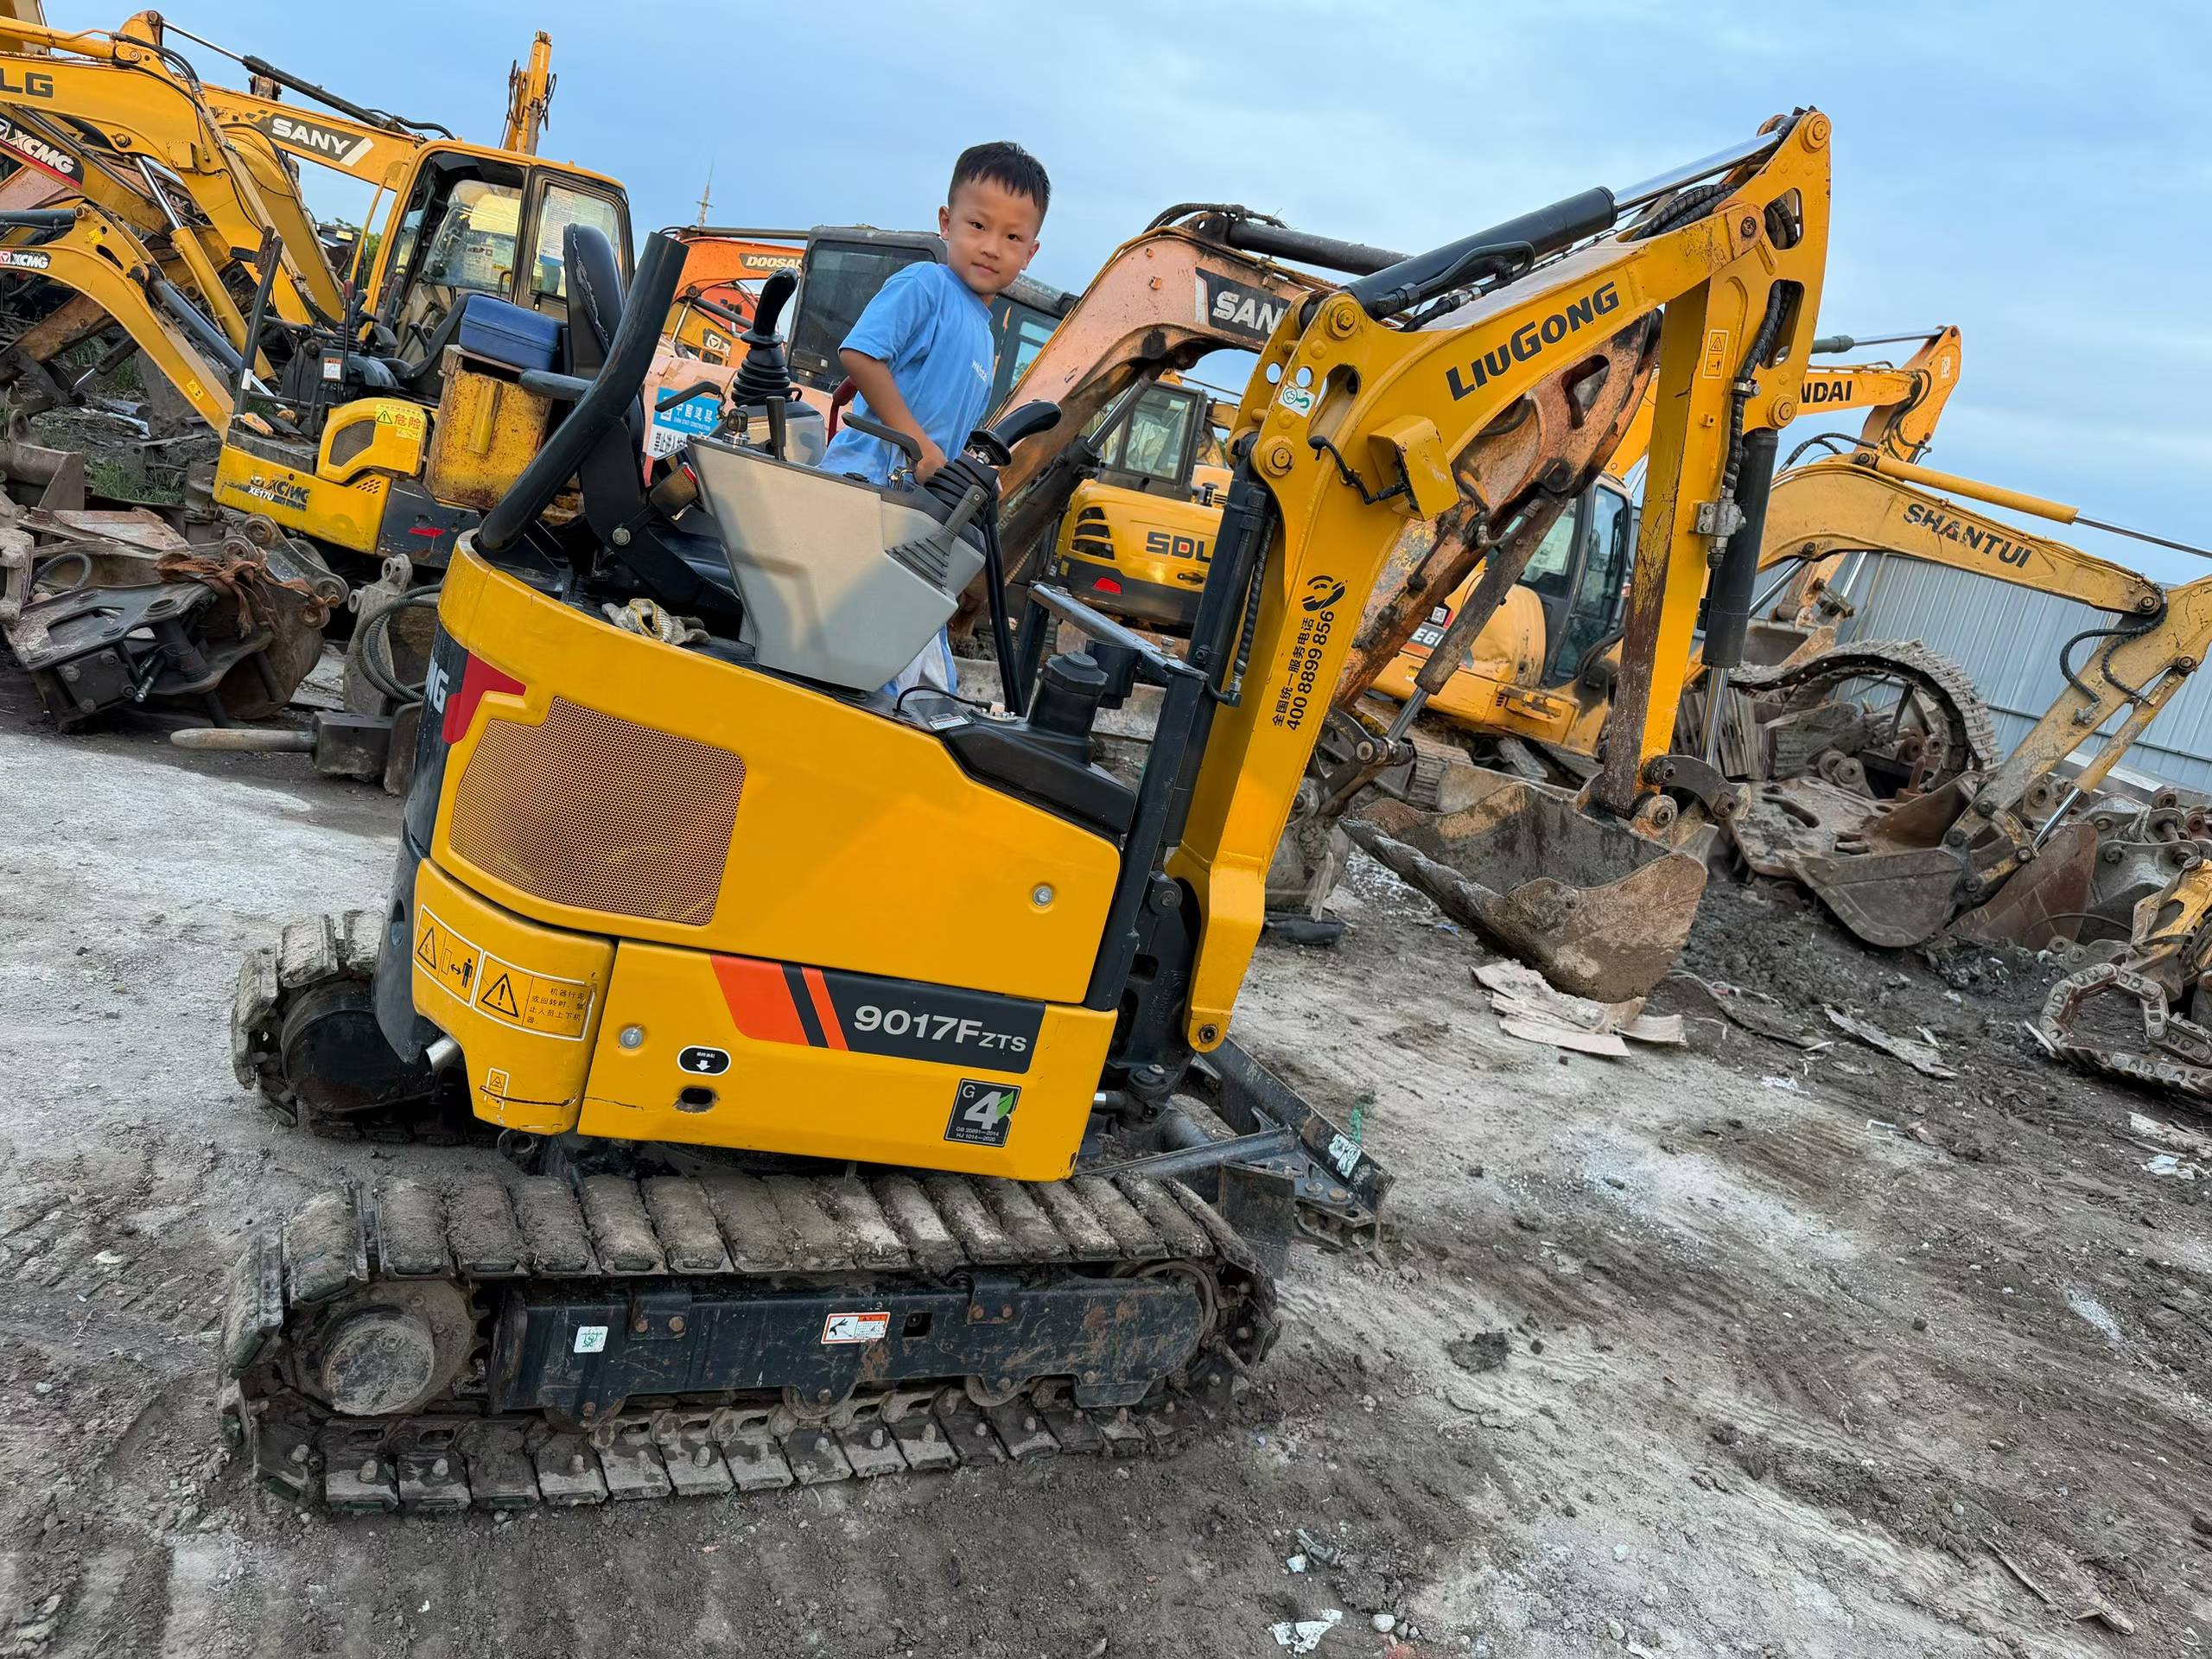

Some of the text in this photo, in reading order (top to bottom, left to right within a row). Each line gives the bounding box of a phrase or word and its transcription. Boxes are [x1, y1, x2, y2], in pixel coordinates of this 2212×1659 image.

[7, 128, 75, 174] XCMG
[271, 118, 351, 155] SANY
[12, 253, 49, 269] XCMG
[1446, 281, 1620, 402] LIUGONG
[394, 413, 422, 430] 危险
[248, 486, 275, 501] XE17U
[1146, 531, 1211, 563] SDL
[1903, 503, 2032, 569] SHANTUI
[1272, 617, 1315, 728] 全国统一服务电话
[1287, 610, 1335, 731] 400 8899 856
[529, 1006, 582, 1021] 止人员上下机
[962, 1084, 976, 1099] G
[963, 1090, 1002, 1130] 4
